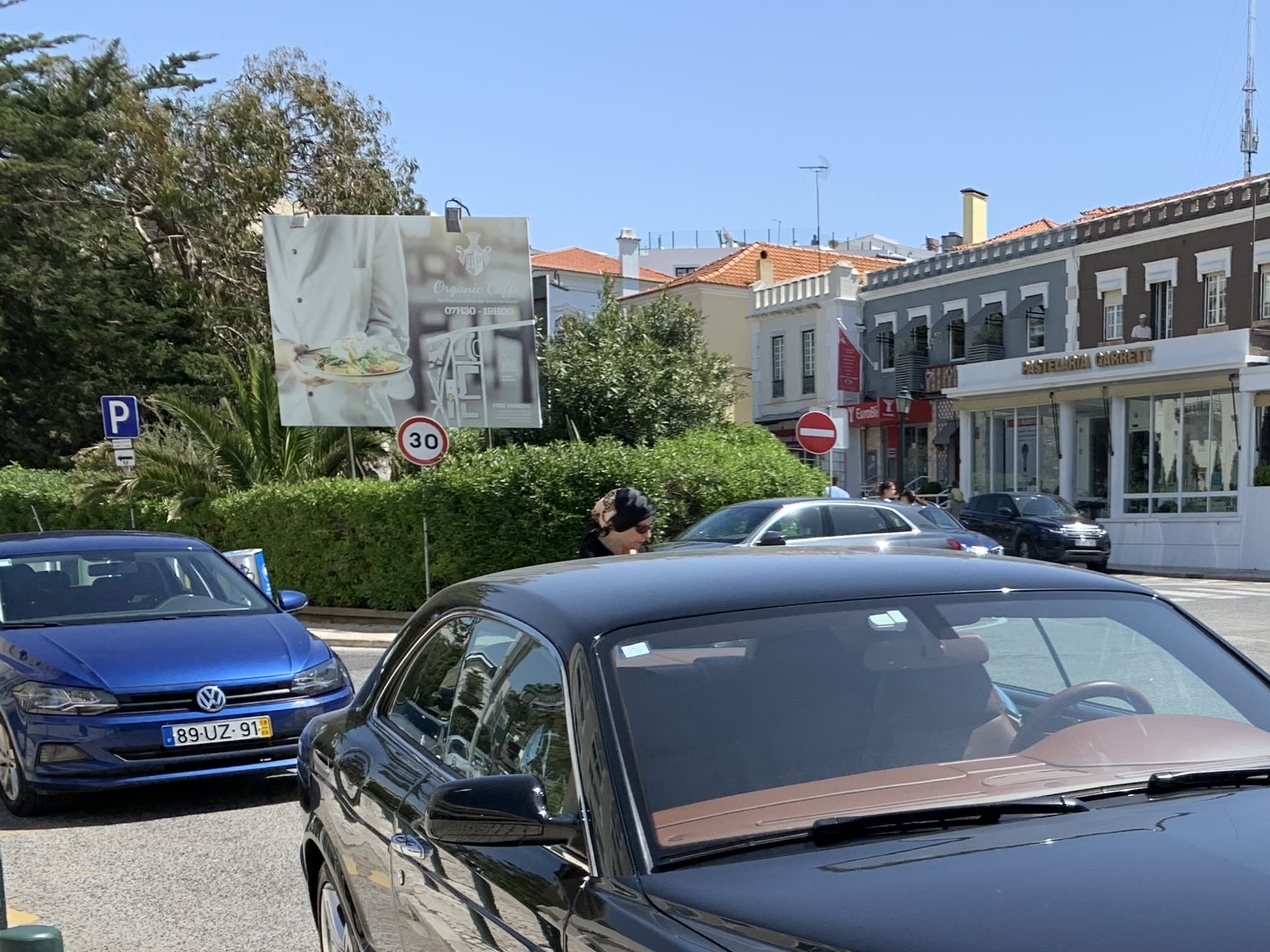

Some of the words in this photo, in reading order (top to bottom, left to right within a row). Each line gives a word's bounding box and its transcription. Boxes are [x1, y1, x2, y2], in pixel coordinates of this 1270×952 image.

[433, 280, 482, 298] Organic
[444, 306, 476, 315] 07H30
[482, 307, 514, 316] 19H00
[1095, 346, 1153, 368] GARRETT
[108, 400, 130, 434] P
[409, 432, 439, 450] 30
